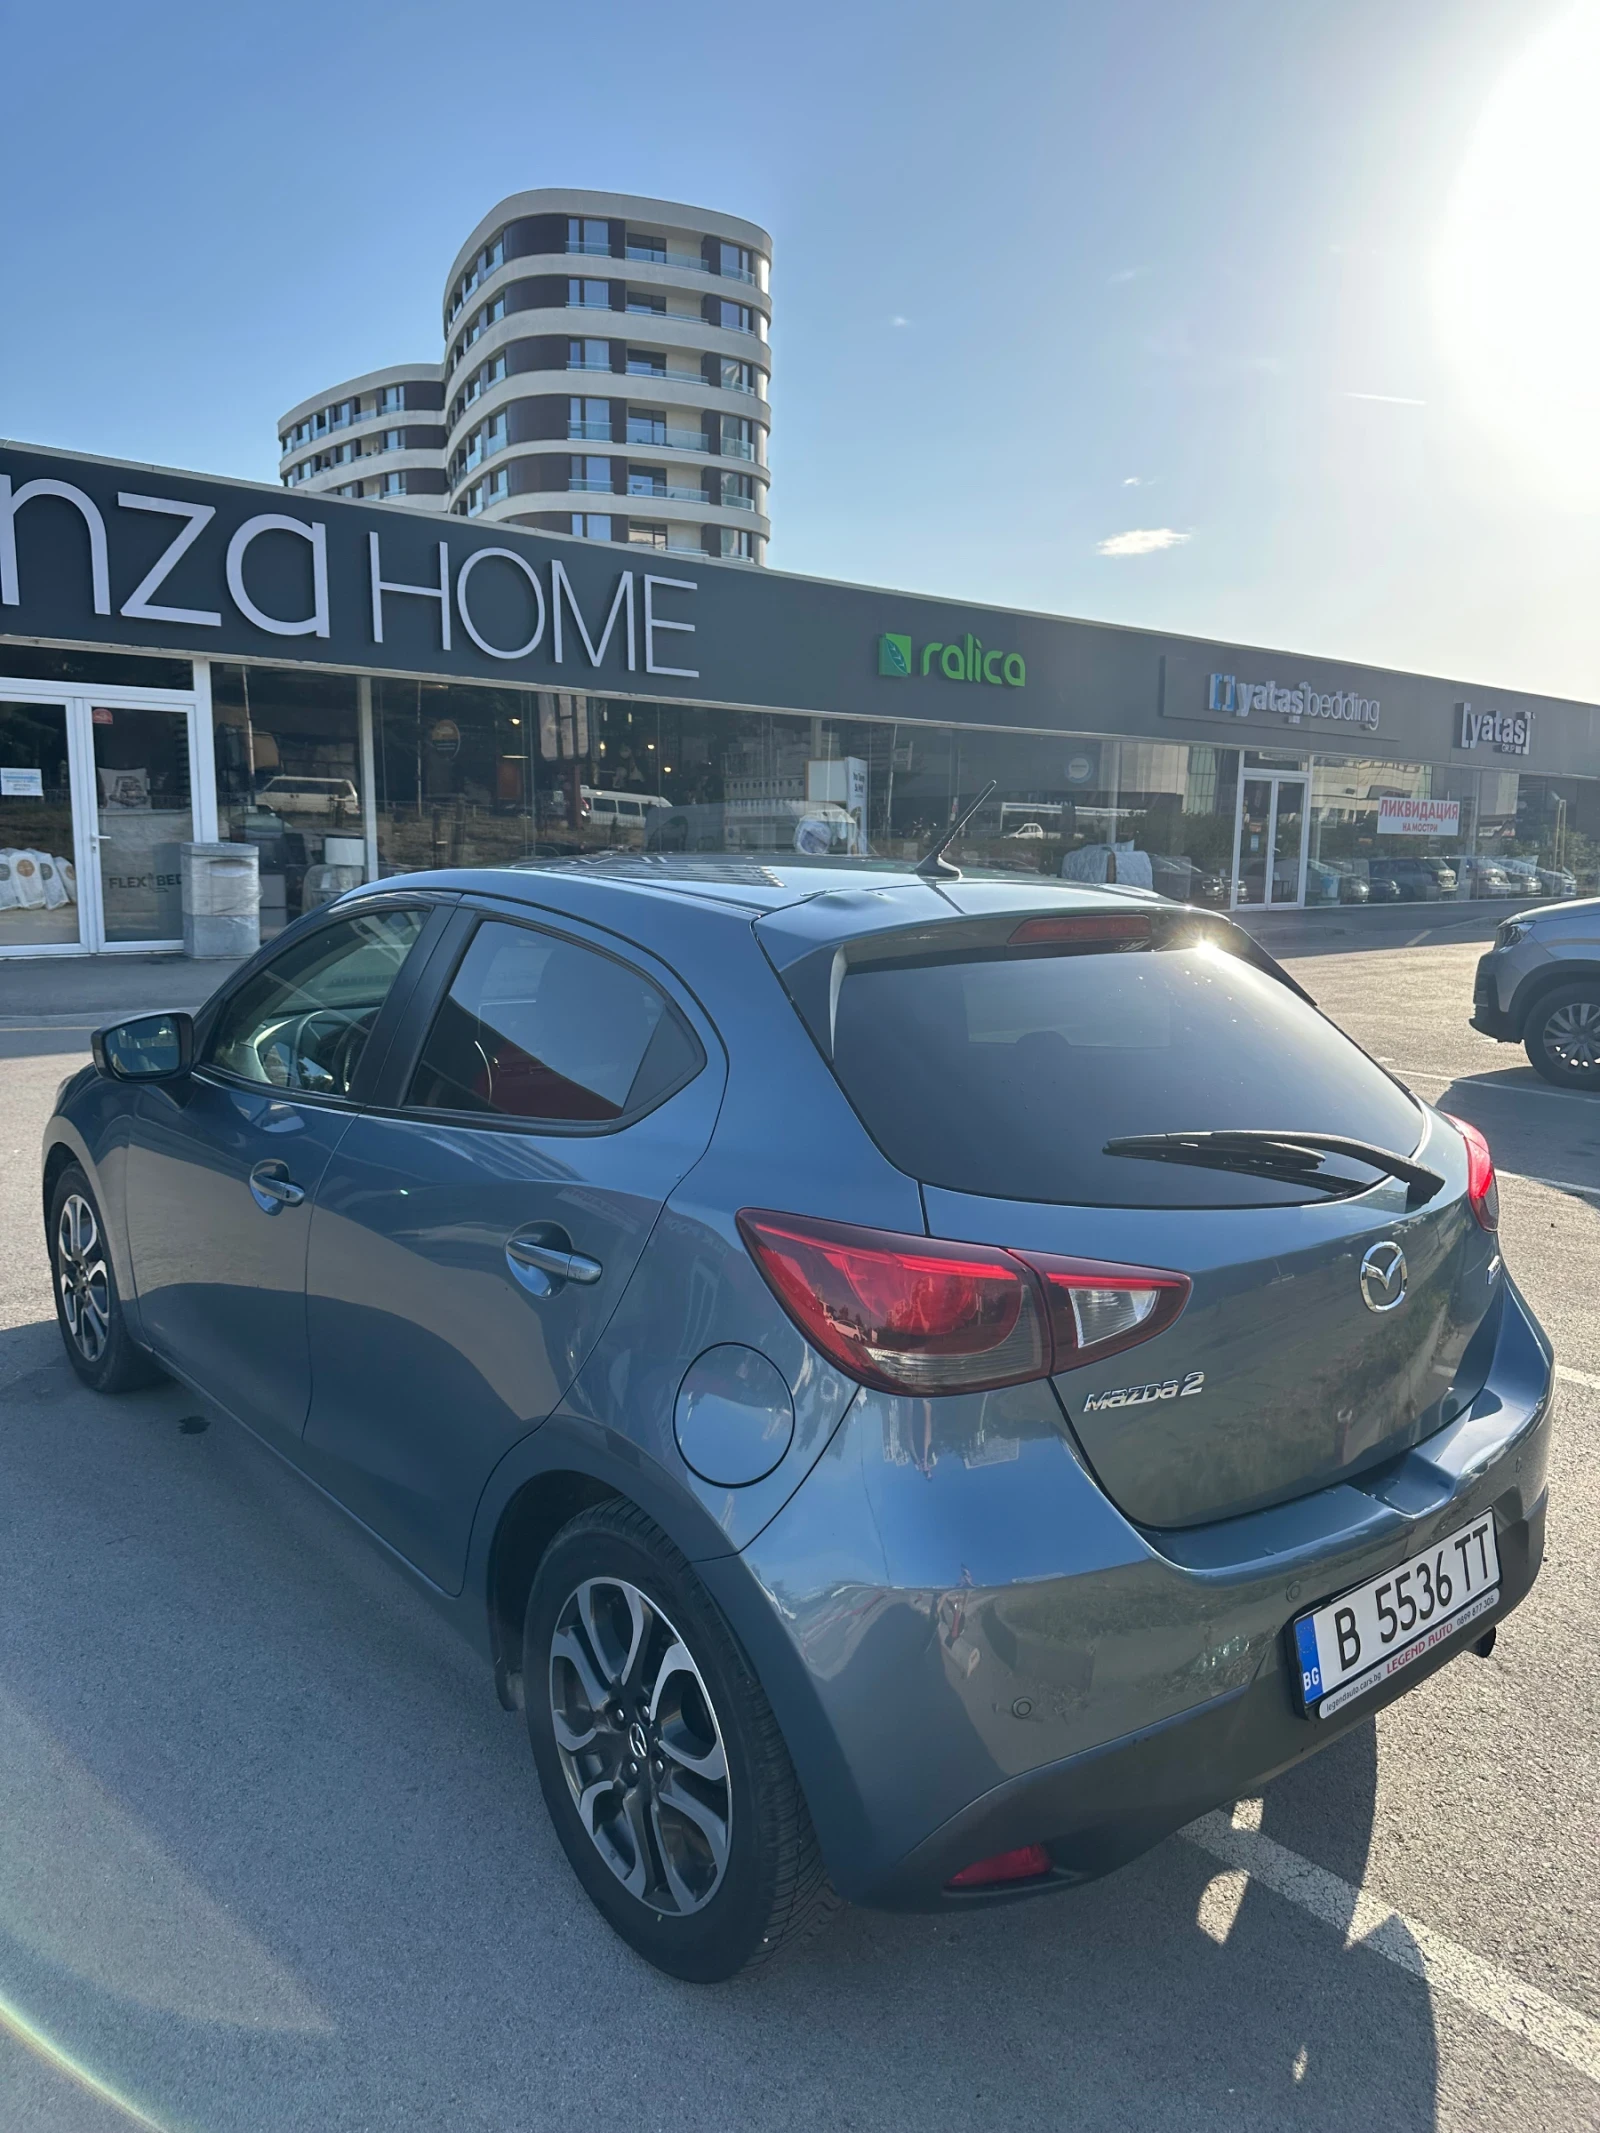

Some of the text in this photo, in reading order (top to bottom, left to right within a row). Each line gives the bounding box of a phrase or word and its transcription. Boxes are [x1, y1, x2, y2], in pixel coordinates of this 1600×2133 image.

[0, 474, 700, 679] nza HOME
[922, 633, 1026, 687] ralica
[1379, 799, 1459, 822] ЛИКВИДАЦИЯ
[1402, 822, 1438, 833] НА МОСТРИ
[108, 876, 147, 889] FLEX
[1180, 1371, 1205, 1397] 2
[1334, 1522, 1489, 1672] B 5536 TT
[1386, 1641, 1426, 1674] LEGEND
[1428, 1623, 1453, 1647] AUTO
[1303, 1666, 1320, 1691] BG
